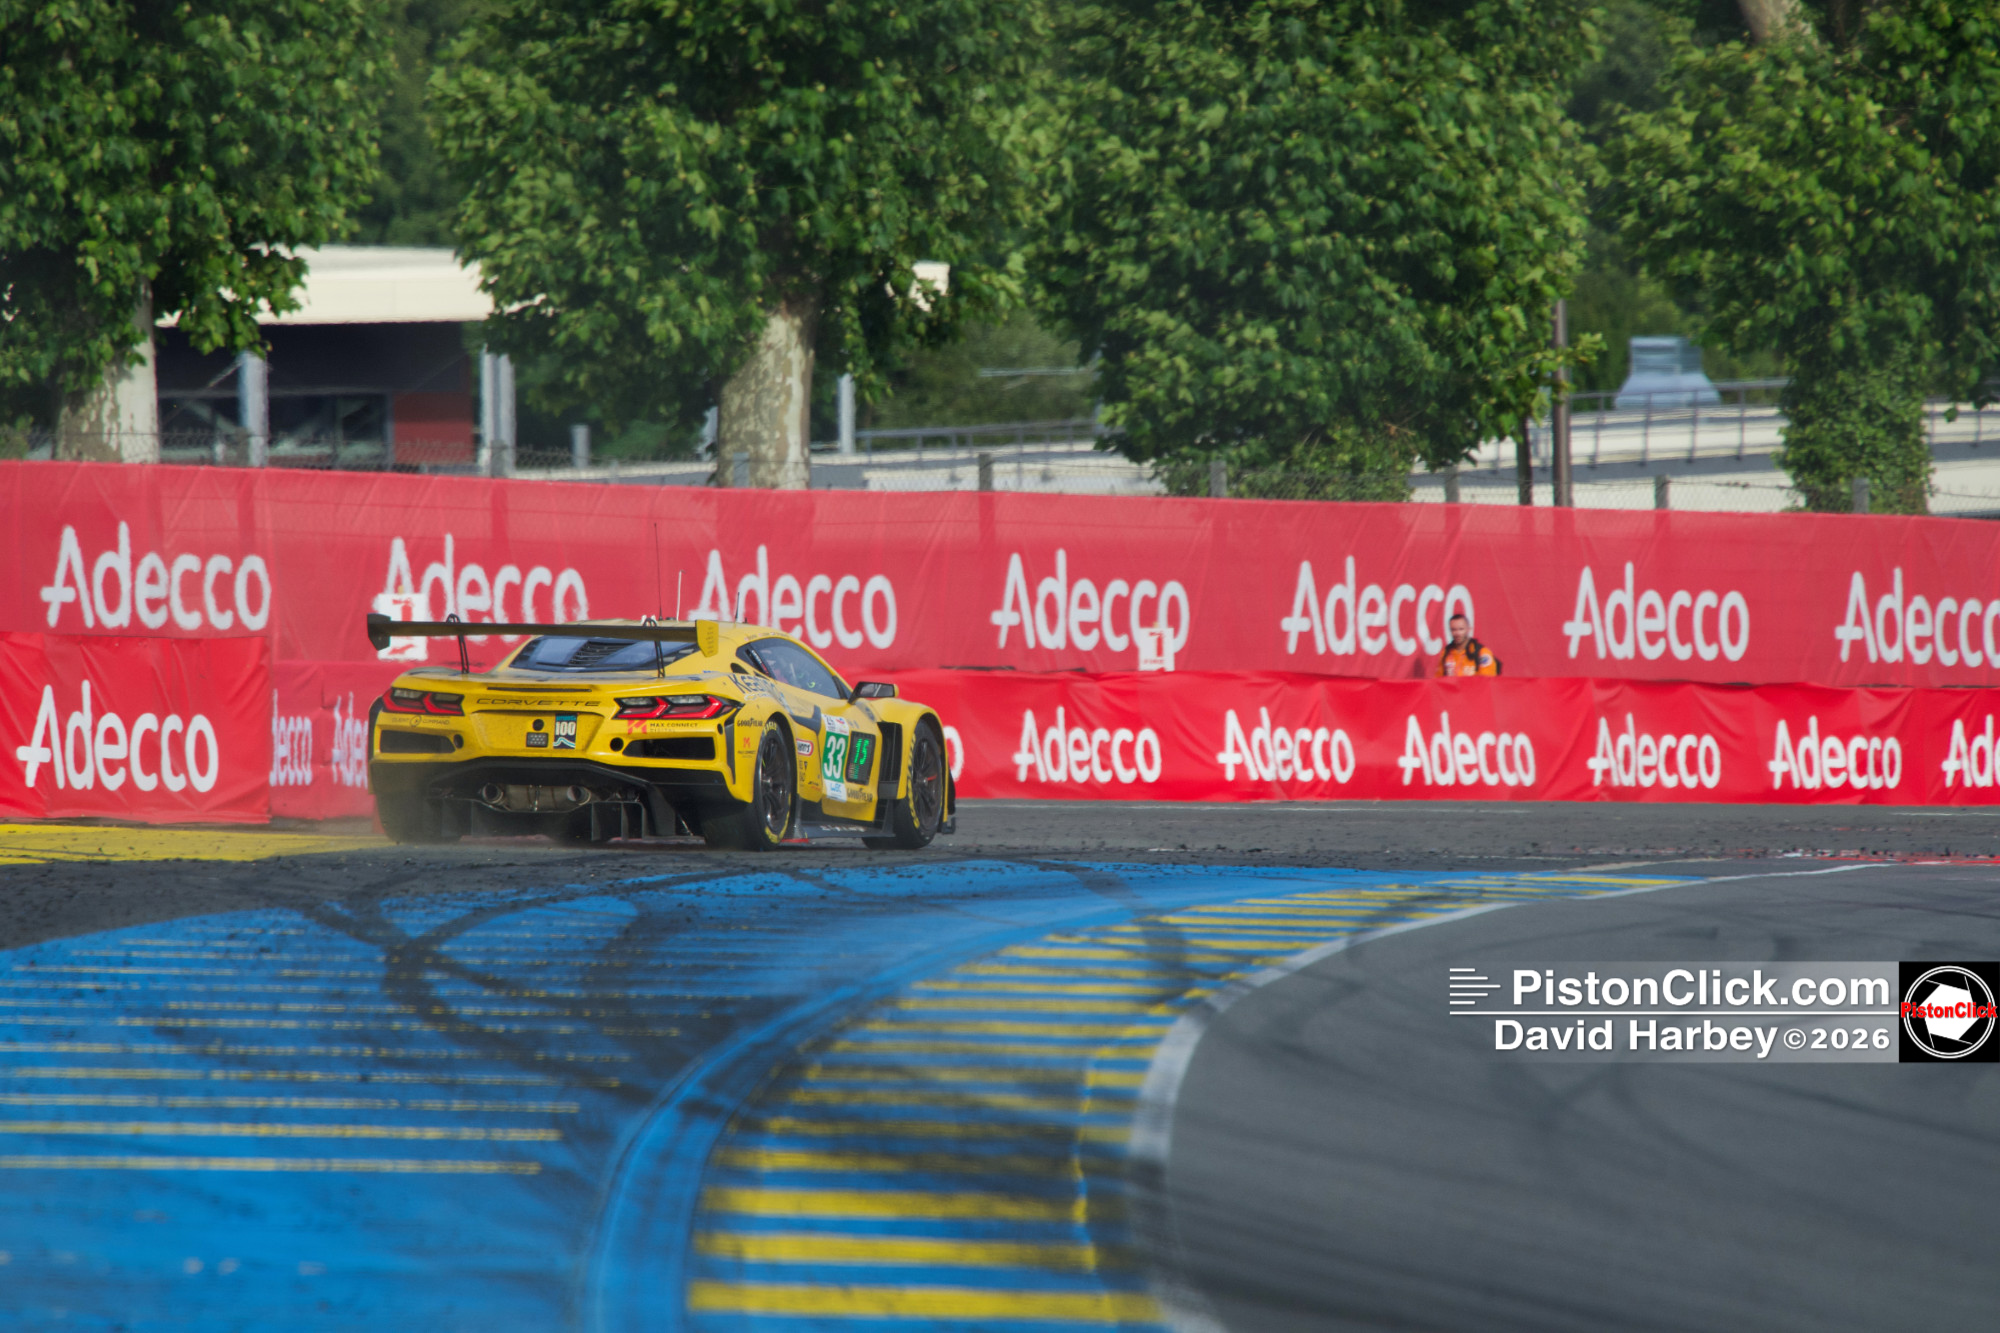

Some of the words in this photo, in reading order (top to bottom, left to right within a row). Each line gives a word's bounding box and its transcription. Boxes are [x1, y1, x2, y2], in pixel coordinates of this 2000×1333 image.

[40, 521, 271, 631] Adecco
[687, 543, 897, 650] Adecco
[990, 548, 1190, 655] Adecco
[1280, 555, 1475, 656] Adecco
[1563, 561, 1750, 662] Adecco
[15, 679, 219, 793] Adecco
[269, 688, 313, 787] decco
[476, 698, 601, 707] CORVETTE
[555, 721, 576, 736] 100
[823, 735, 846, 779] 33
[854, 738, 870, 765] 15
[1012, 706, 1162, 784] Adecco
[1216, 706, 1356, 784] Adecco
[1397, 711, 1536, 787] Adecco
[1586, 712, 1721, 789] Adecco
[1768, 715, 1902, 790] Adecco
